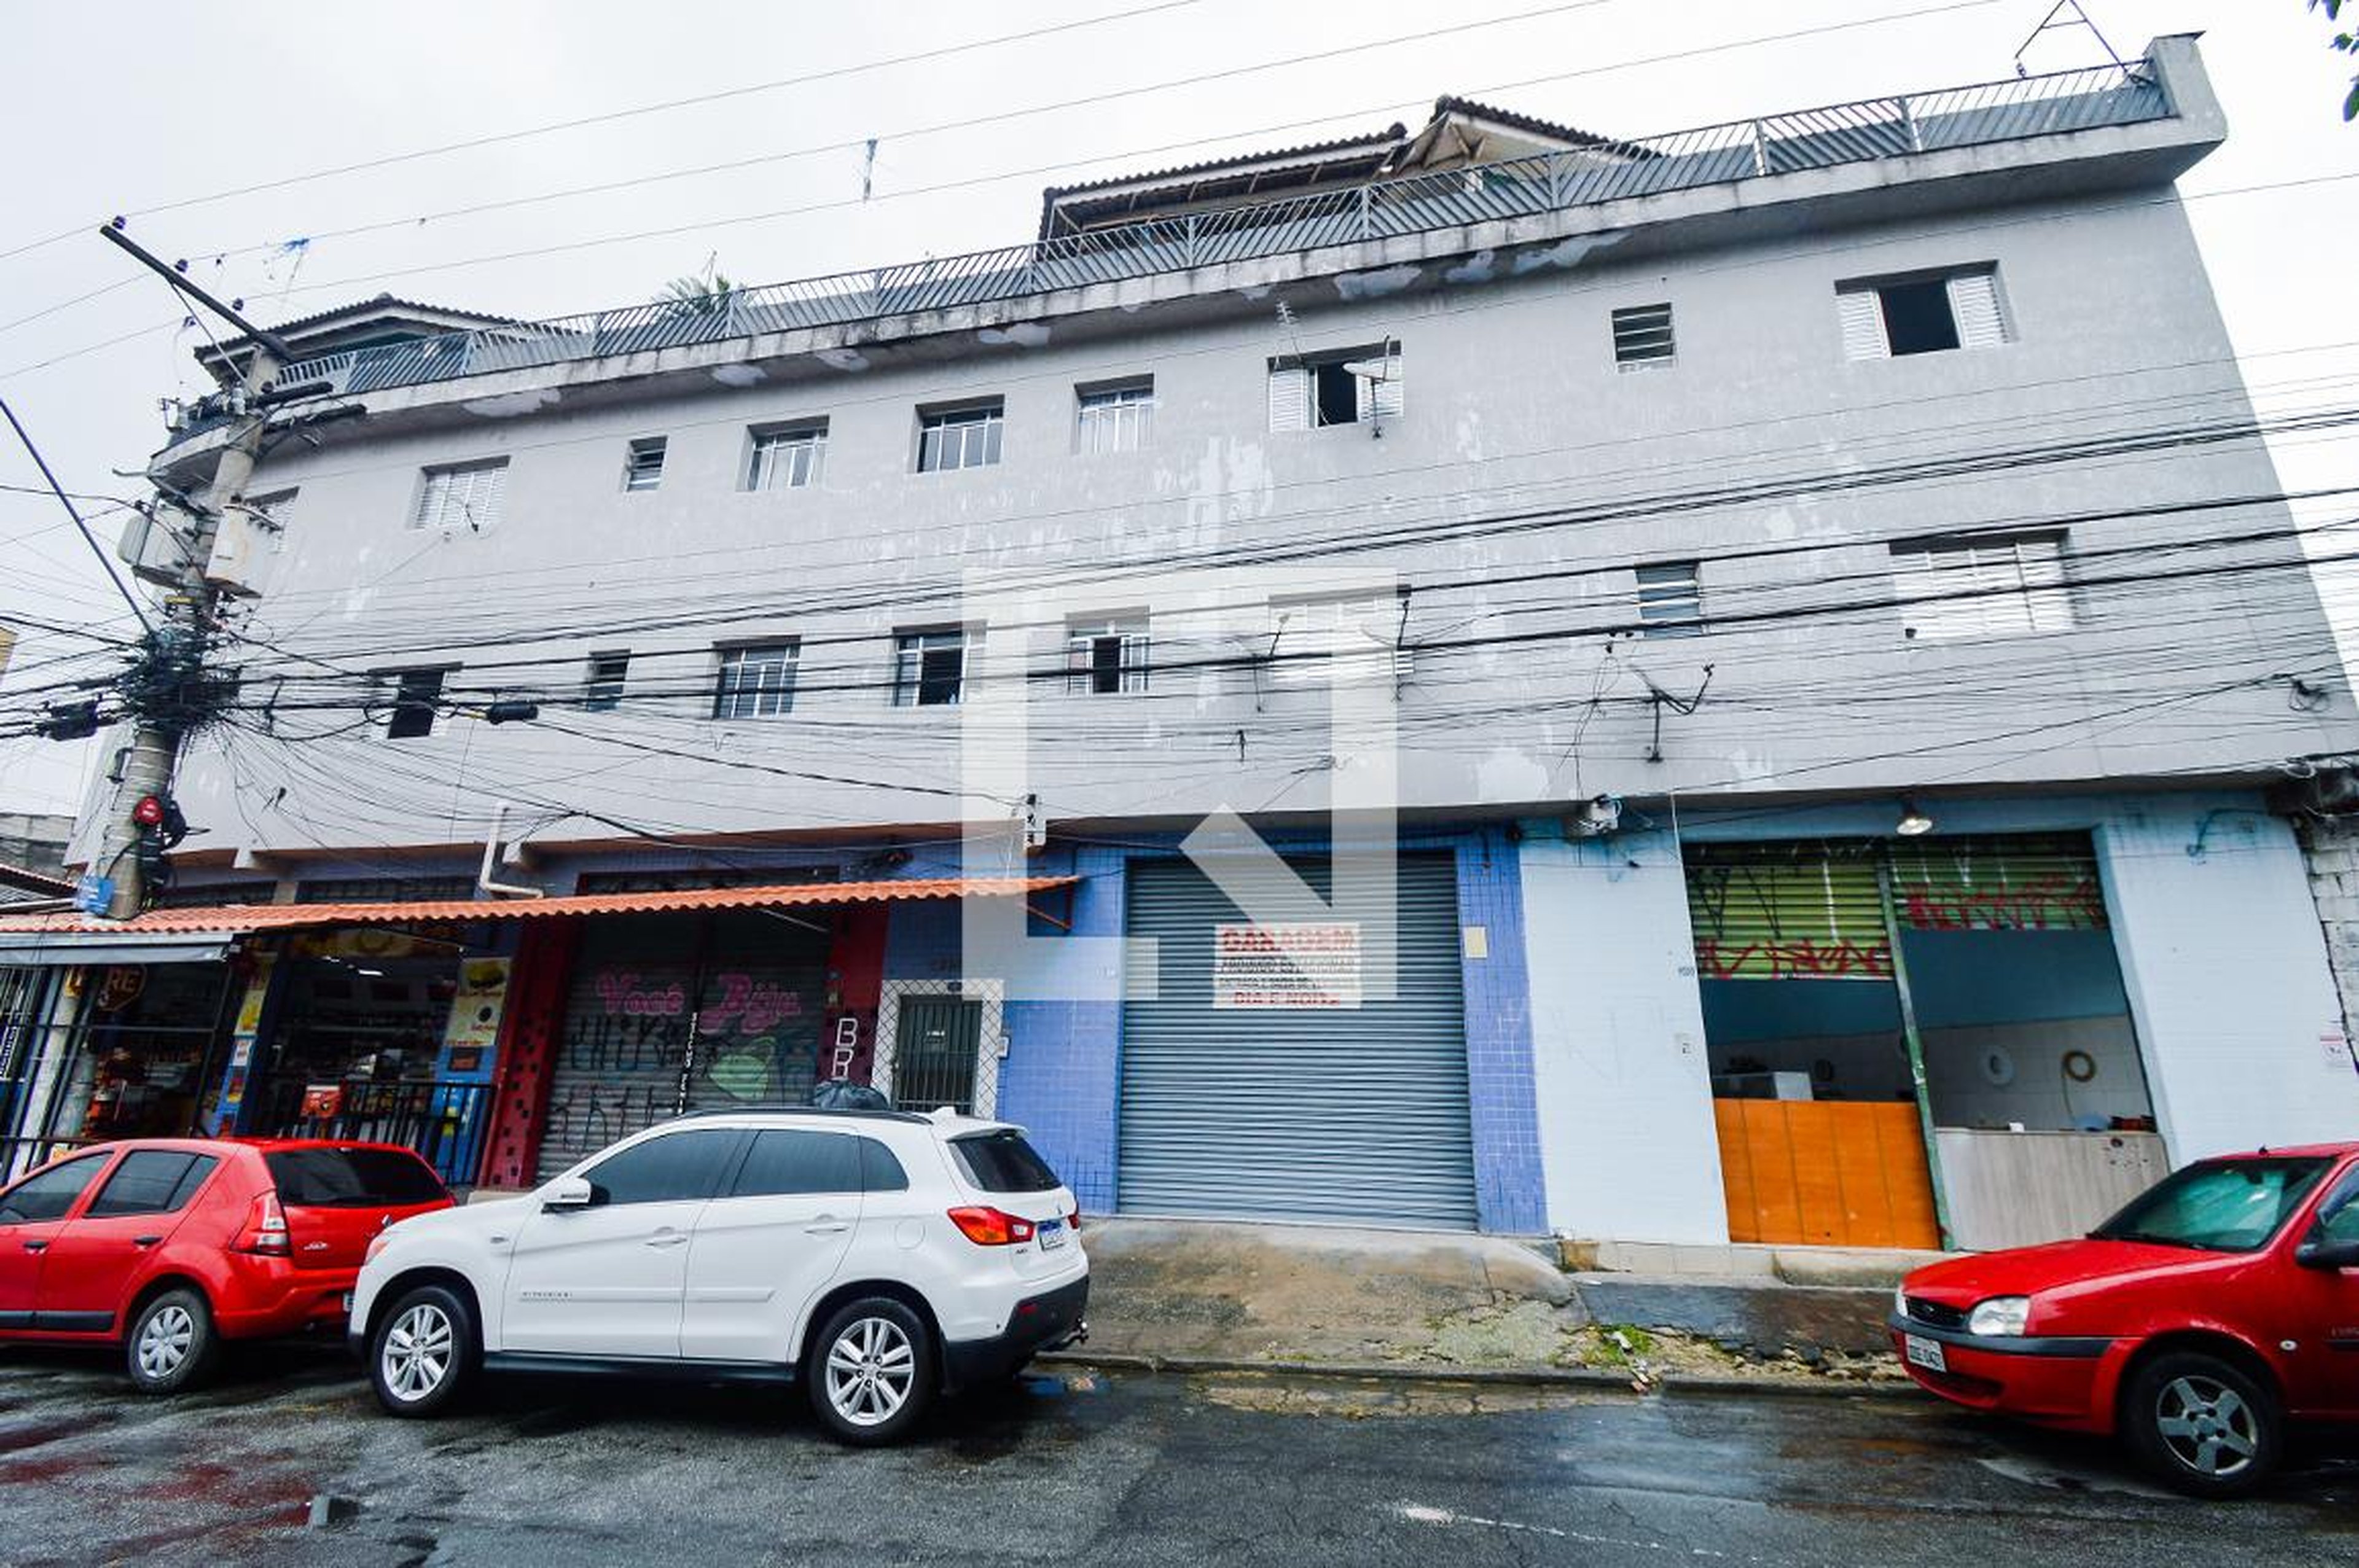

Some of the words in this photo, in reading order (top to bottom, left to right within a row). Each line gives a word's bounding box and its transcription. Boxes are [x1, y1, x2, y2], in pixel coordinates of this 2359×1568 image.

[1221, 926, 1355, 951] GARAGEM
[1234, 991, 1262, 1005] DIA
[1269, 991, 1277, 1004] E
[831, 1017, 858, 1080] BR
